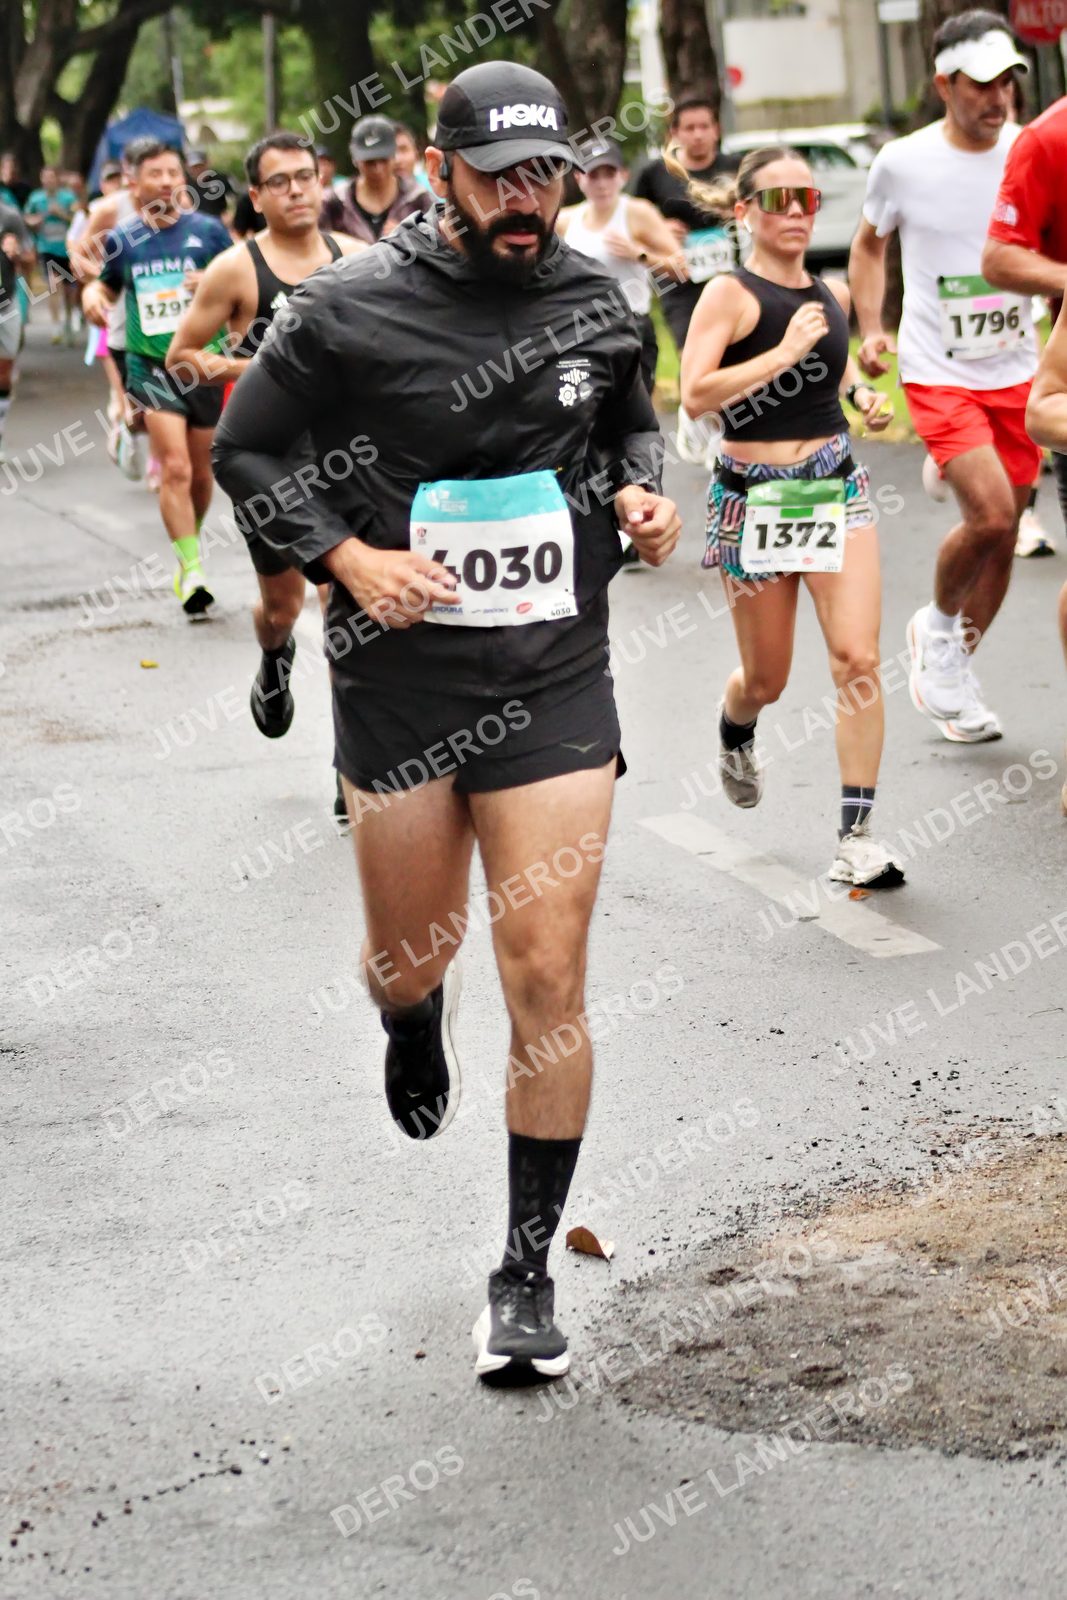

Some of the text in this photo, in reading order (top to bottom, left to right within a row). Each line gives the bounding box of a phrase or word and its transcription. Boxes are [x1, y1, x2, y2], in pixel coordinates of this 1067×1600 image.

[490, 103, 558, 132] HOKA
[132, 257, 197, 279] PIRMA
[950, 306, 1019, 338] 1796
[755, 521, 836, 550] 1372
